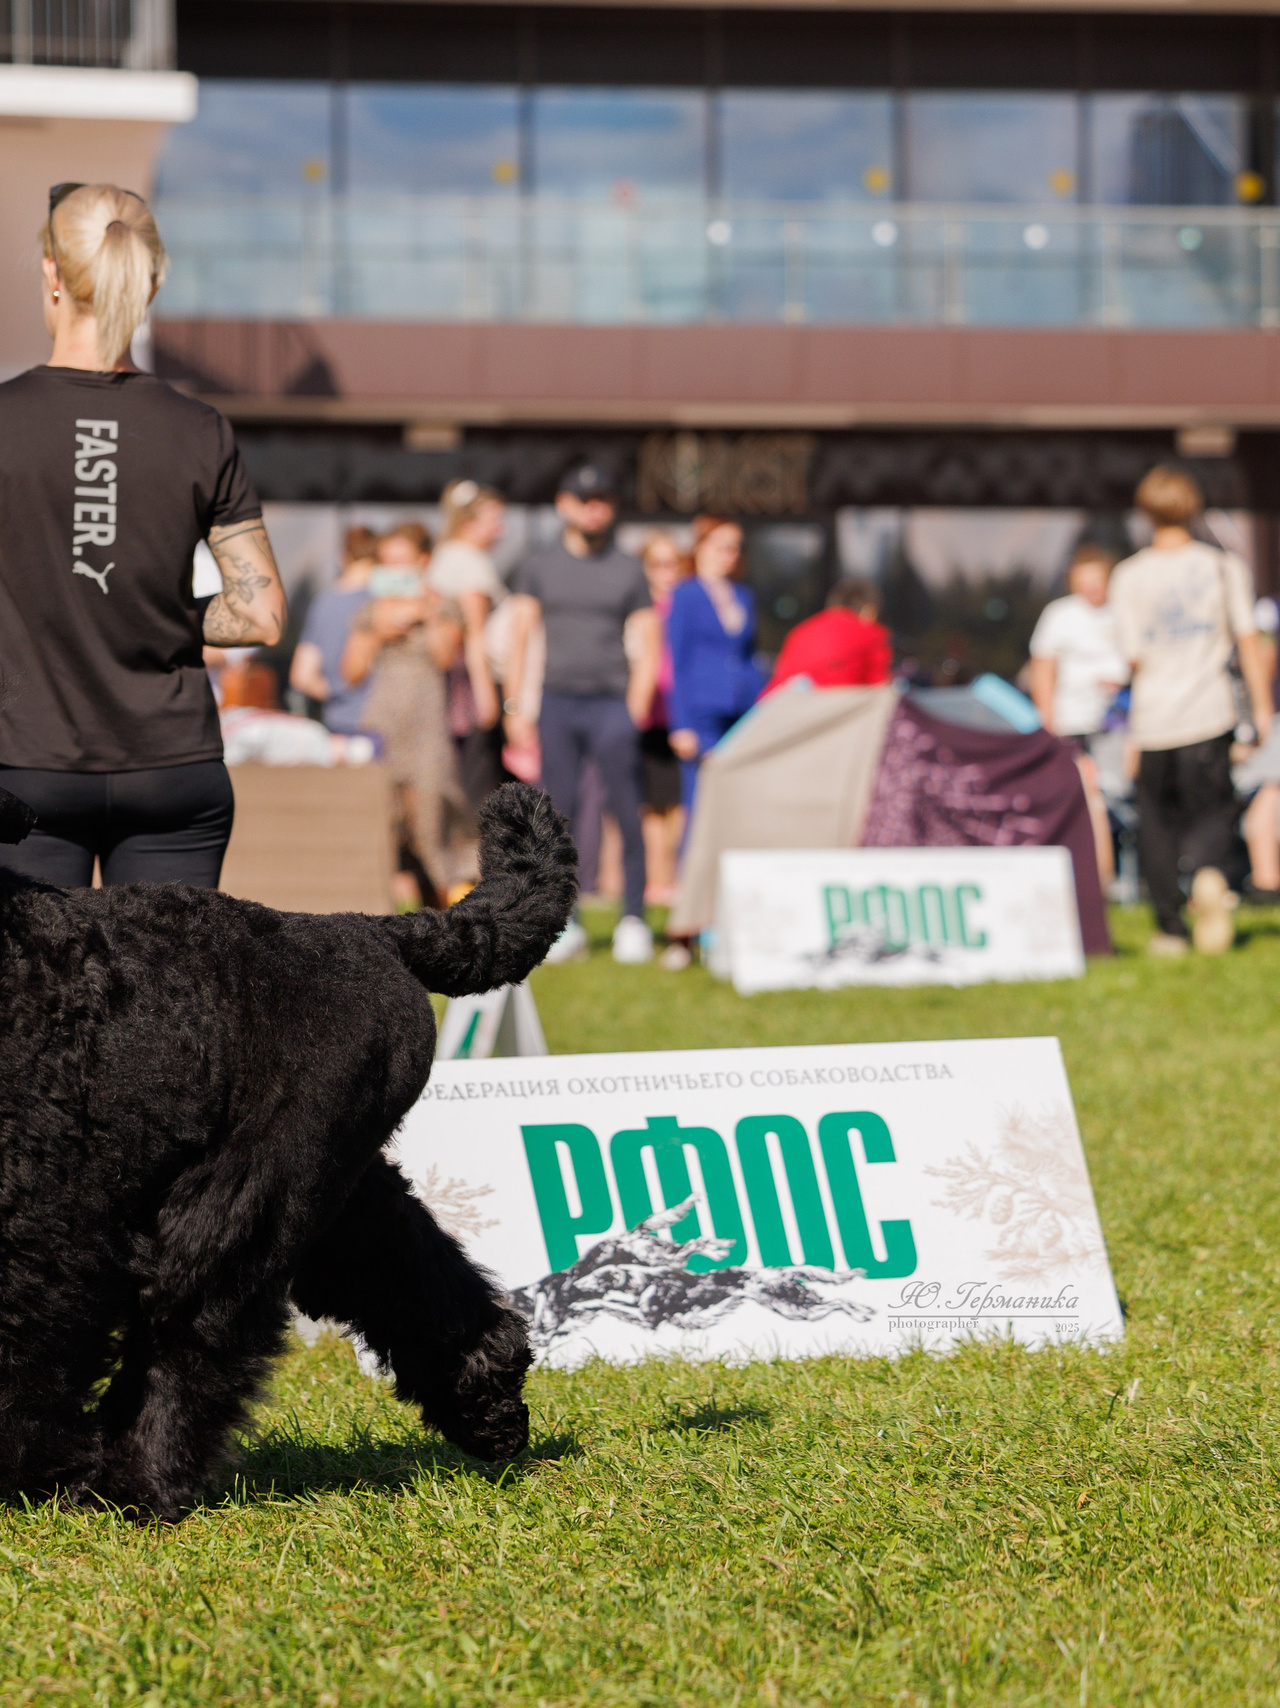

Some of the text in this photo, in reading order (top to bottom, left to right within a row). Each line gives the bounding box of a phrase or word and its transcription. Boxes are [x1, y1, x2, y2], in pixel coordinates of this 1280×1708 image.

[73, 418, 119, 556] FASTER.
[567, 1070, 744, 1096] ОХОТНИЧЬЕГО
[749, 1063, 954, 1089] СОБАКОВОДСТВА
